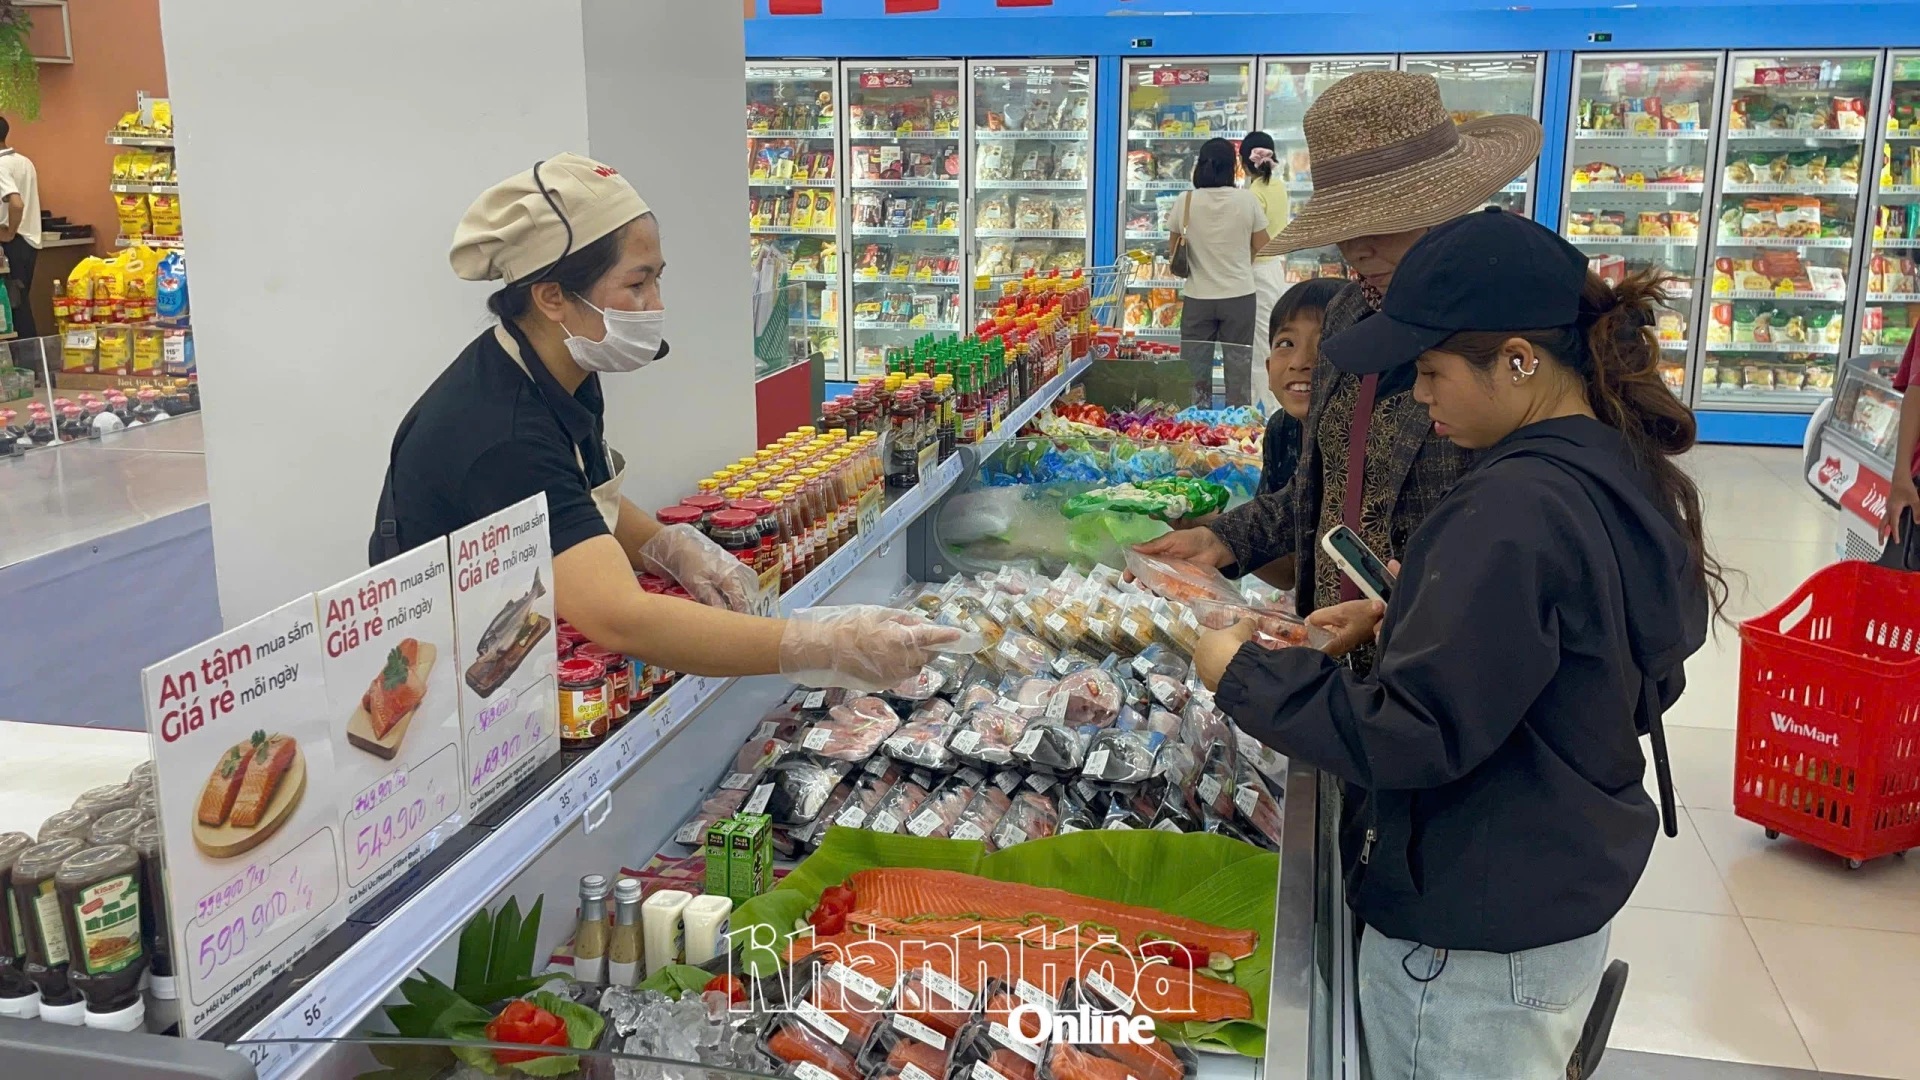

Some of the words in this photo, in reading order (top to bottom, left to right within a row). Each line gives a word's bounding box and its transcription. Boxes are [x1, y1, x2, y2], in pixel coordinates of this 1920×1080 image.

[458, 540, 479, 565] An
[482, 524, 510, 552] tâm
[512, 521, 530, 538] mua
[458, 559, 482, 592] Giá
[485, 550, 500, 579] rẻ
[518, 544, 538, 562] ngày
[326, 597, 354, 628] An
[358, 578, 397, 611] tâm
[400, 573, 423, 592] mua
[425, 561, 445, 580] sắm
[327, 620, 360, 658] Giá
[364, 607, 383, 641] rẻ
[387, 607, 407, 631] mỗi
[408, 597, 433, 619] ngày
[159, 670, 197, 709] An
[200, 644, 252, 685] tâm
[256, 635, 286, 660] mua
[287, 621, 314, 644] sắm
[161, 696, 204, 743] Giá
[210, 680, 235, 720] rẻ
[240, 677, 267, 705] mỗi
[269, 663, 299, 690] ngày
[1770, 711, 1839, 747] WinMart
[559, 792, 571, 809] 35
[588, 772, 598, 788] 23
[303, 1003, 321, 1026] 56
